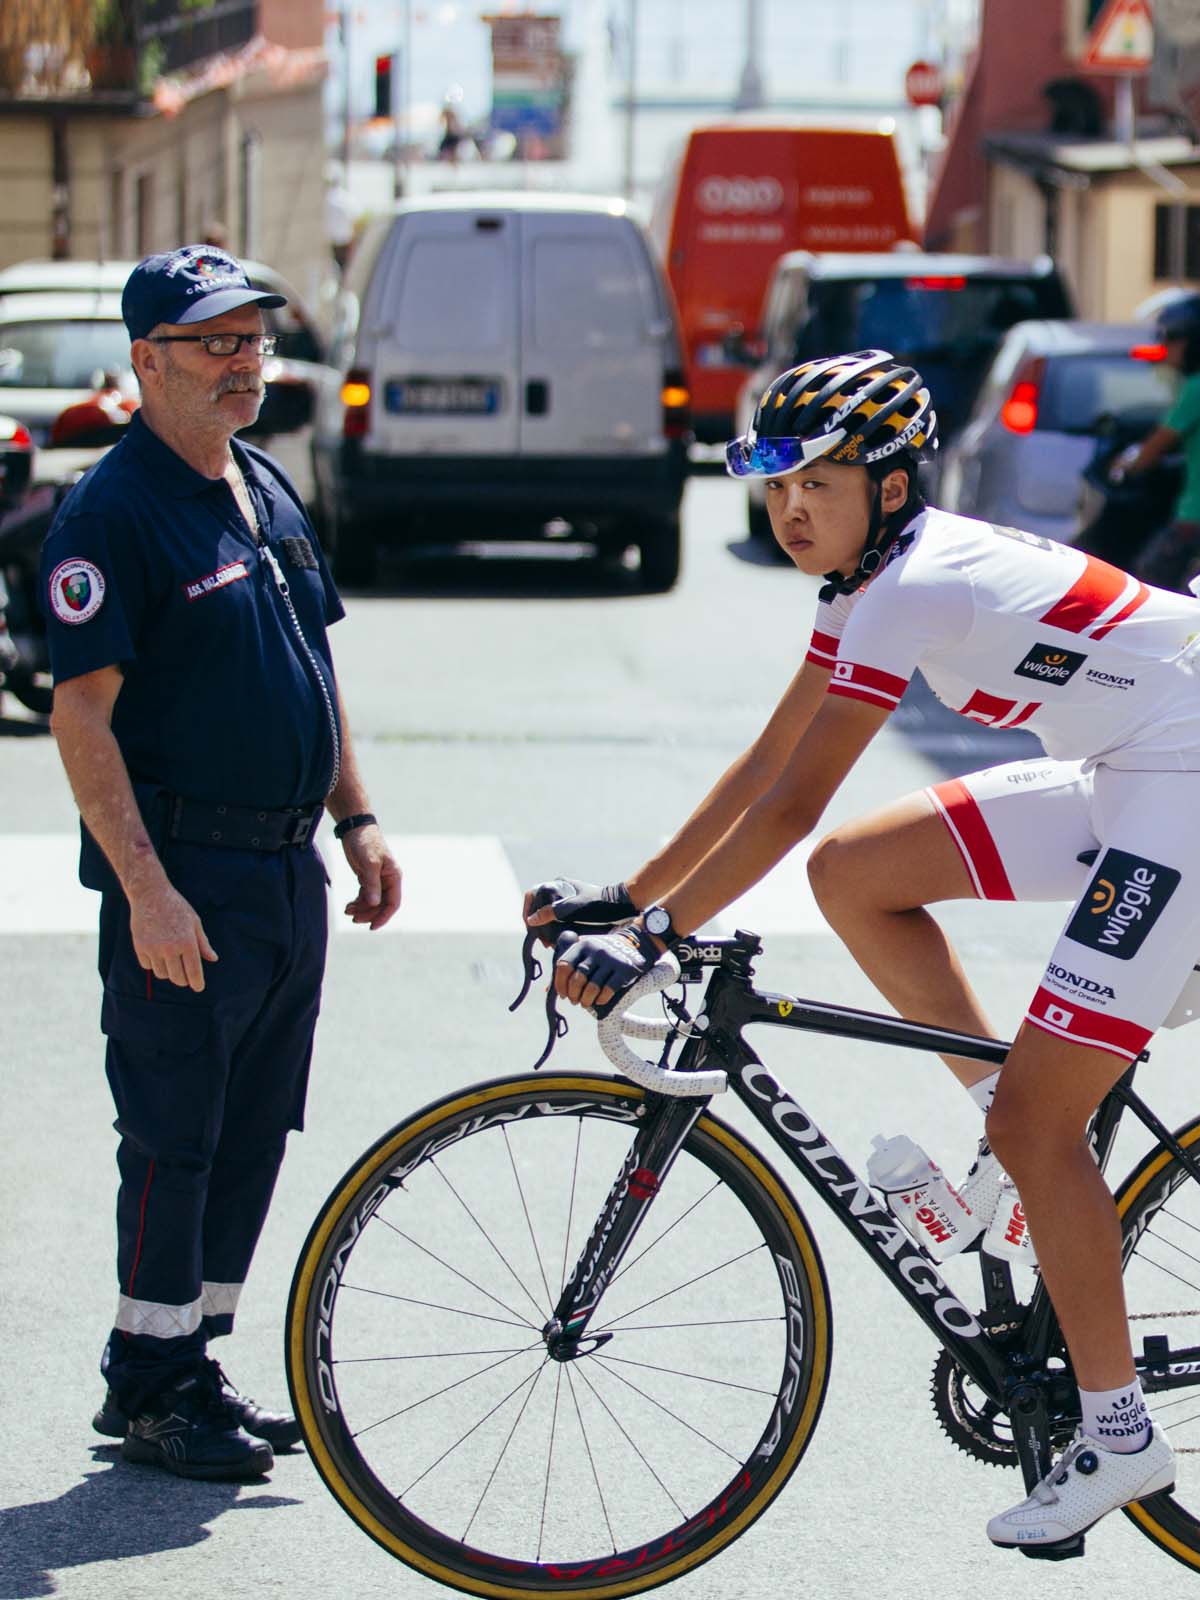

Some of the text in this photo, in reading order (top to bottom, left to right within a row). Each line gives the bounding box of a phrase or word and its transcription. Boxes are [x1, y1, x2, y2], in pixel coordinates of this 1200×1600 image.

[832, 434, 865, 460] wiggle
[865, 418, 925, 463] HONDA
[1024, 660, 1070, 679] wiggle
[1086, 669, 1135, 686] HONDA
[1098, 867, 1157, 946] wiggle
[1047, 962, 1116, 1000] HONDA
[741, 1063, 981, 1338] COLNAGO
[1004, 1202, 1026, 1247] HIG
[757, 1252, 805, 1458] BORA
[1096, 1402, 1146, 1425] wiggle
[1097, 1417, 1152, 1436] HONDA
